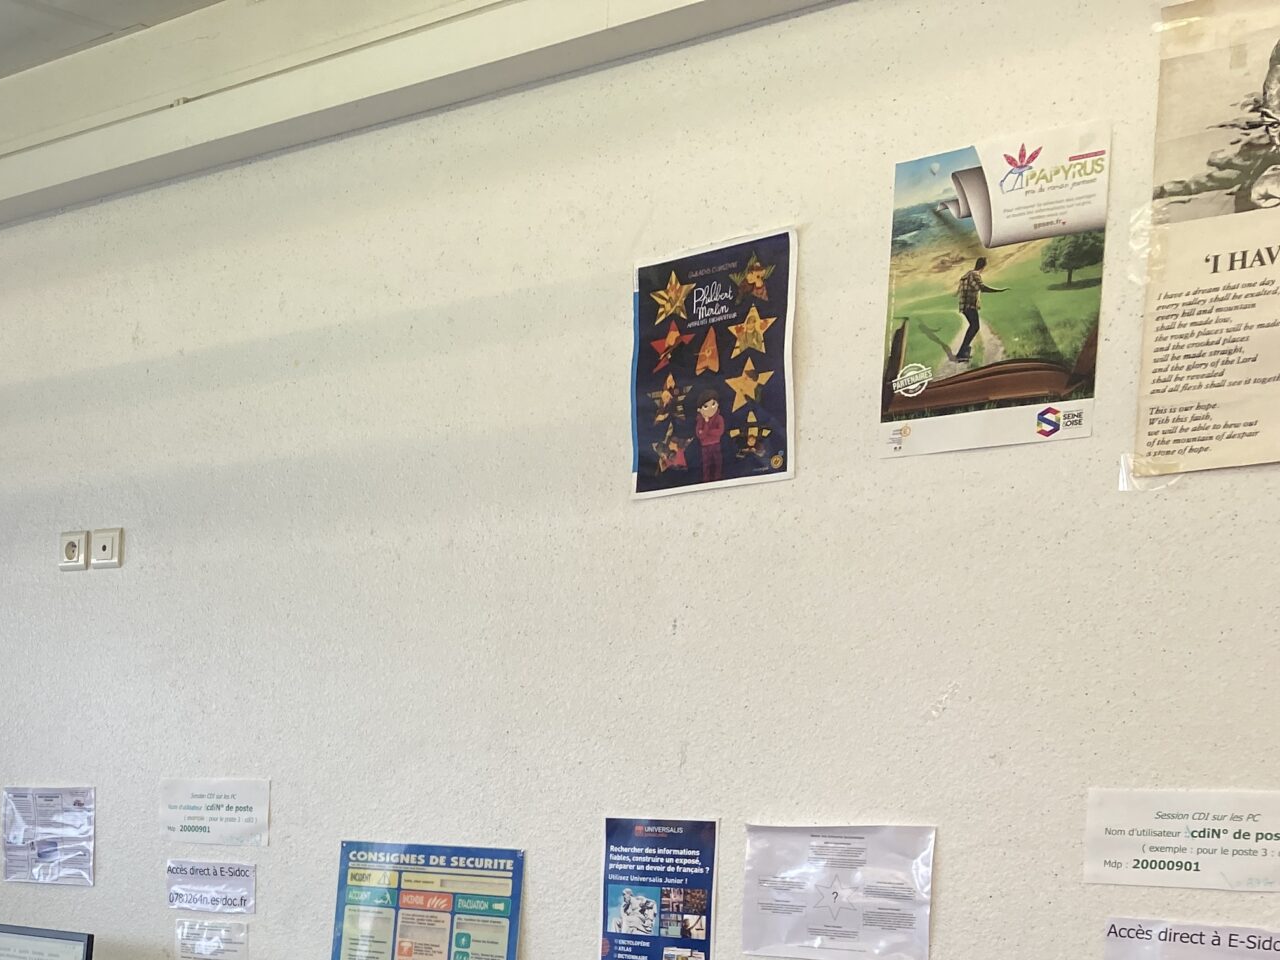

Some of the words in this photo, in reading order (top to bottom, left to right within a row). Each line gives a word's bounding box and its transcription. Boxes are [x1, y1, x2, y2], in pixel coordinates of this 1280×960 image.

[1026, 157, 1104, 186] PAPYRUS
[892, 369, 932, 391] PARTENAIRES
[1154, 811, 1189, 820] Session
[1229, 813, 1243, 822] les
[1246, 813, 1261, 822] PC
[180, 825, 210, 833] 20000901
[1105, 827, 1125, 836] Nom
[1128, 828, 1181, 837] d'utilisateur
[1233, 829, 1251, 840] de
[610, 845, 643, 854] Rechercher
[657, 848, 700, 856] informations
[1149, 845, 1187, 854] exemple
[1197, 847, 1217, 855] pour
[1221, 846, 1229, 855] le
[1232, 847, 1258, 857] poste
[1261, 848, 1267, 857] 3
[348, 851, 426, 865] CONSIGNES
[429, 856, 446, 866] DE
[450, 856, 514, 870] SECURITE
[610, 854, 631, 862] fiables,
[675, 857, 701, 865] exposé,
[1132, 859, 1200, 872] 20000901
[167, 865, 187, 875] Accès
[190, 866, 210, 876] direct
[213, 866, 217, 876] à
[220, 867, 249, 877] E-Sidoc
[677, 866, 704, 874] français
[832, 891, 838, 903] ?
[457, 899, 489, 910] EVACUATION
[1107, 924, 1152, 940] Accès
[1158, 928, 1205, 945] direct
[1211, 931, 1221, 946] à
